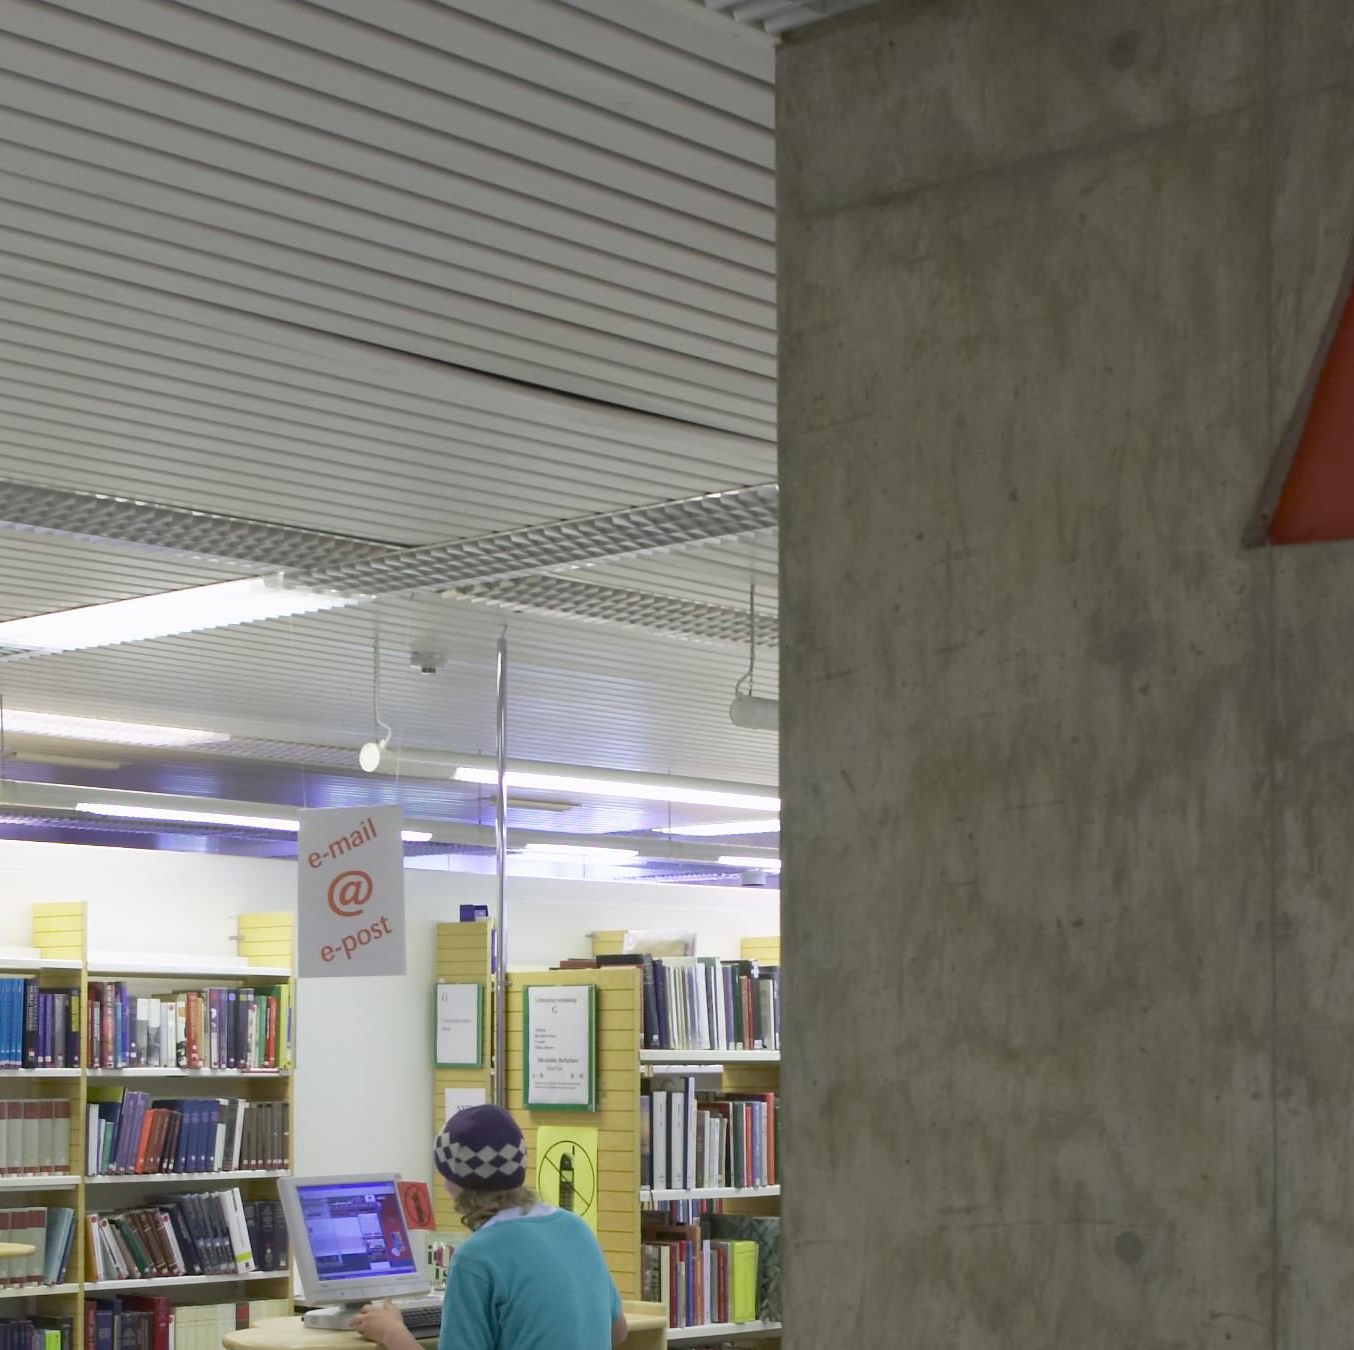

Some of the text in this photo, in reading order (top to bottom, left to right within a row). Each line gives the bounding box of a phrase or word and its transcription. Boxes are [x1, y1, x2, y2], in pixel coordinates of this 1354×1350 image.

[308, 817, 377, 868] e-mail
[327, 870, 373, 917] @
[321, 915, 393, 962] e-post
